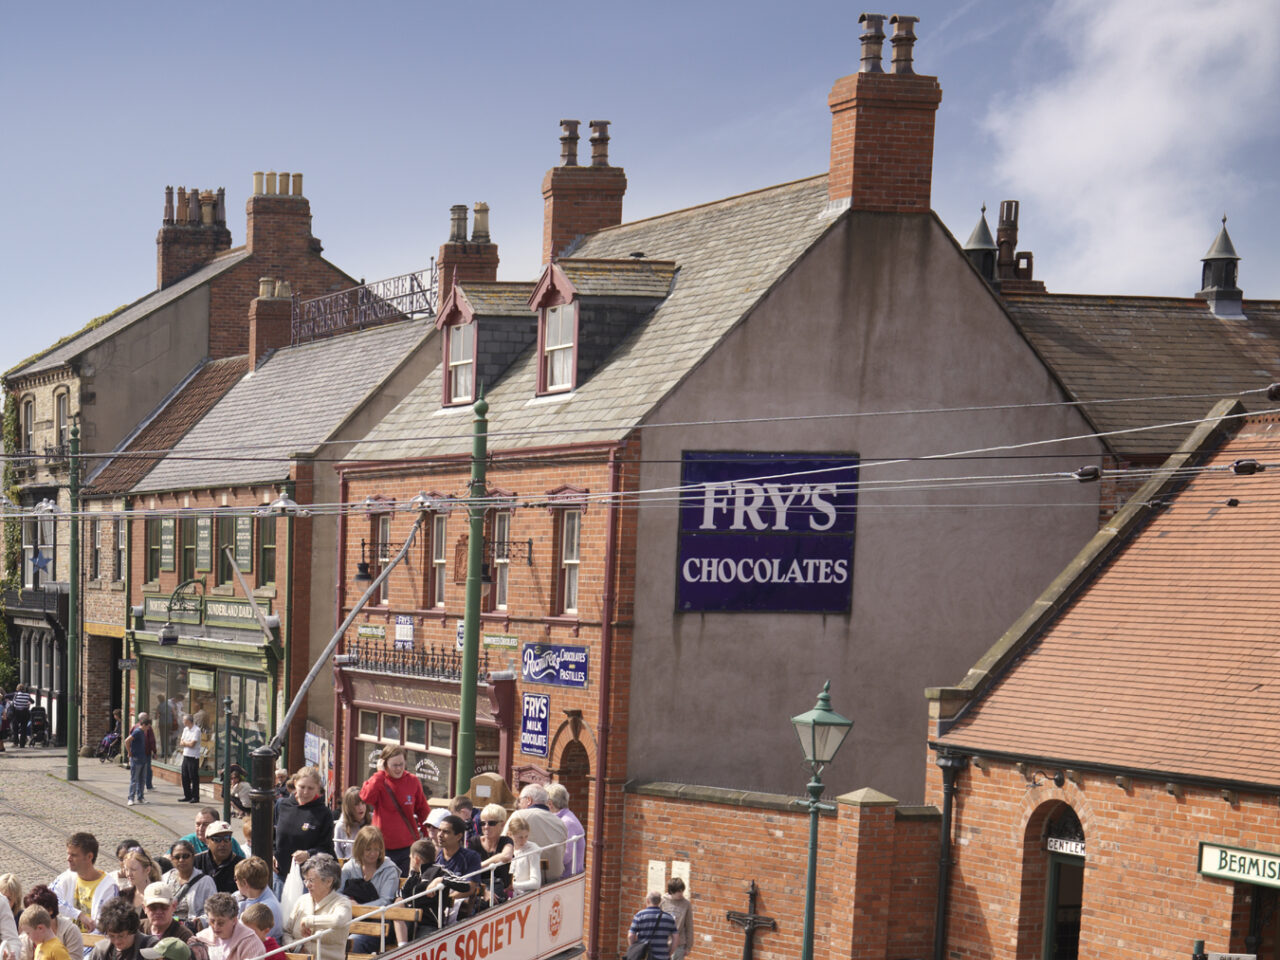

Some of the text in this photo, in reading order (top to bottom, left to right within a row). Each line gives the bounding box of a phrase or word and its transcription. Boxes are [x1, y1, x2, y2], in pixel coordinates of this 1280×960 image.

[699, 481, 838, 532] FRY'S
[682, 557, 848, 584] CHOCOLATES
[526, 719, 543, 732] MILK
